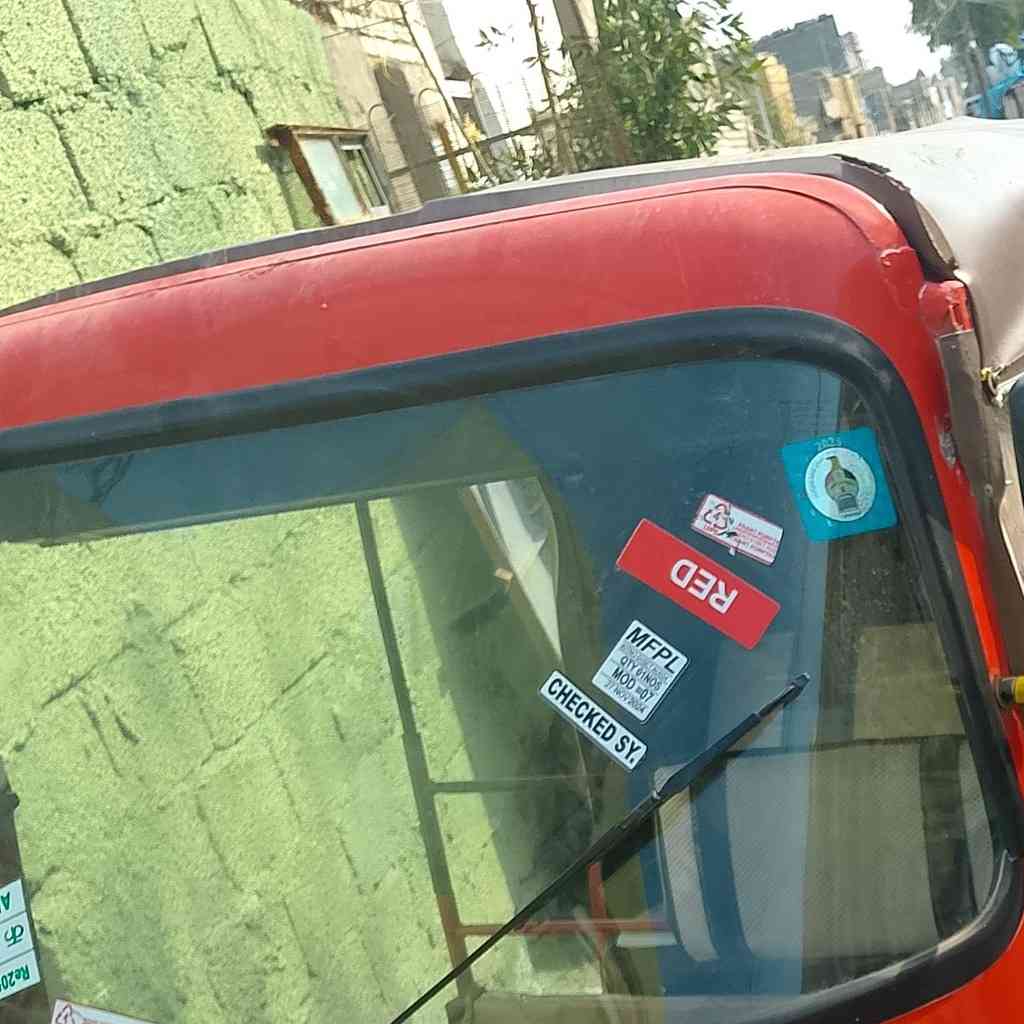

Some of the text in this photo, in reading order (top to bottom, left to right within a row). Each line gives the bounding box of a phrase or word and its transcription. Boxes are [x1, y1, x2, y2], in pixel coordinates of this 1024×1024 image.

[670, 558, 739, 615] RED
[625, 626, 681, 675] MFPL
[548, 678, 641, 763] CHECKED SY.
[0, 964, 30, 993] Re20
